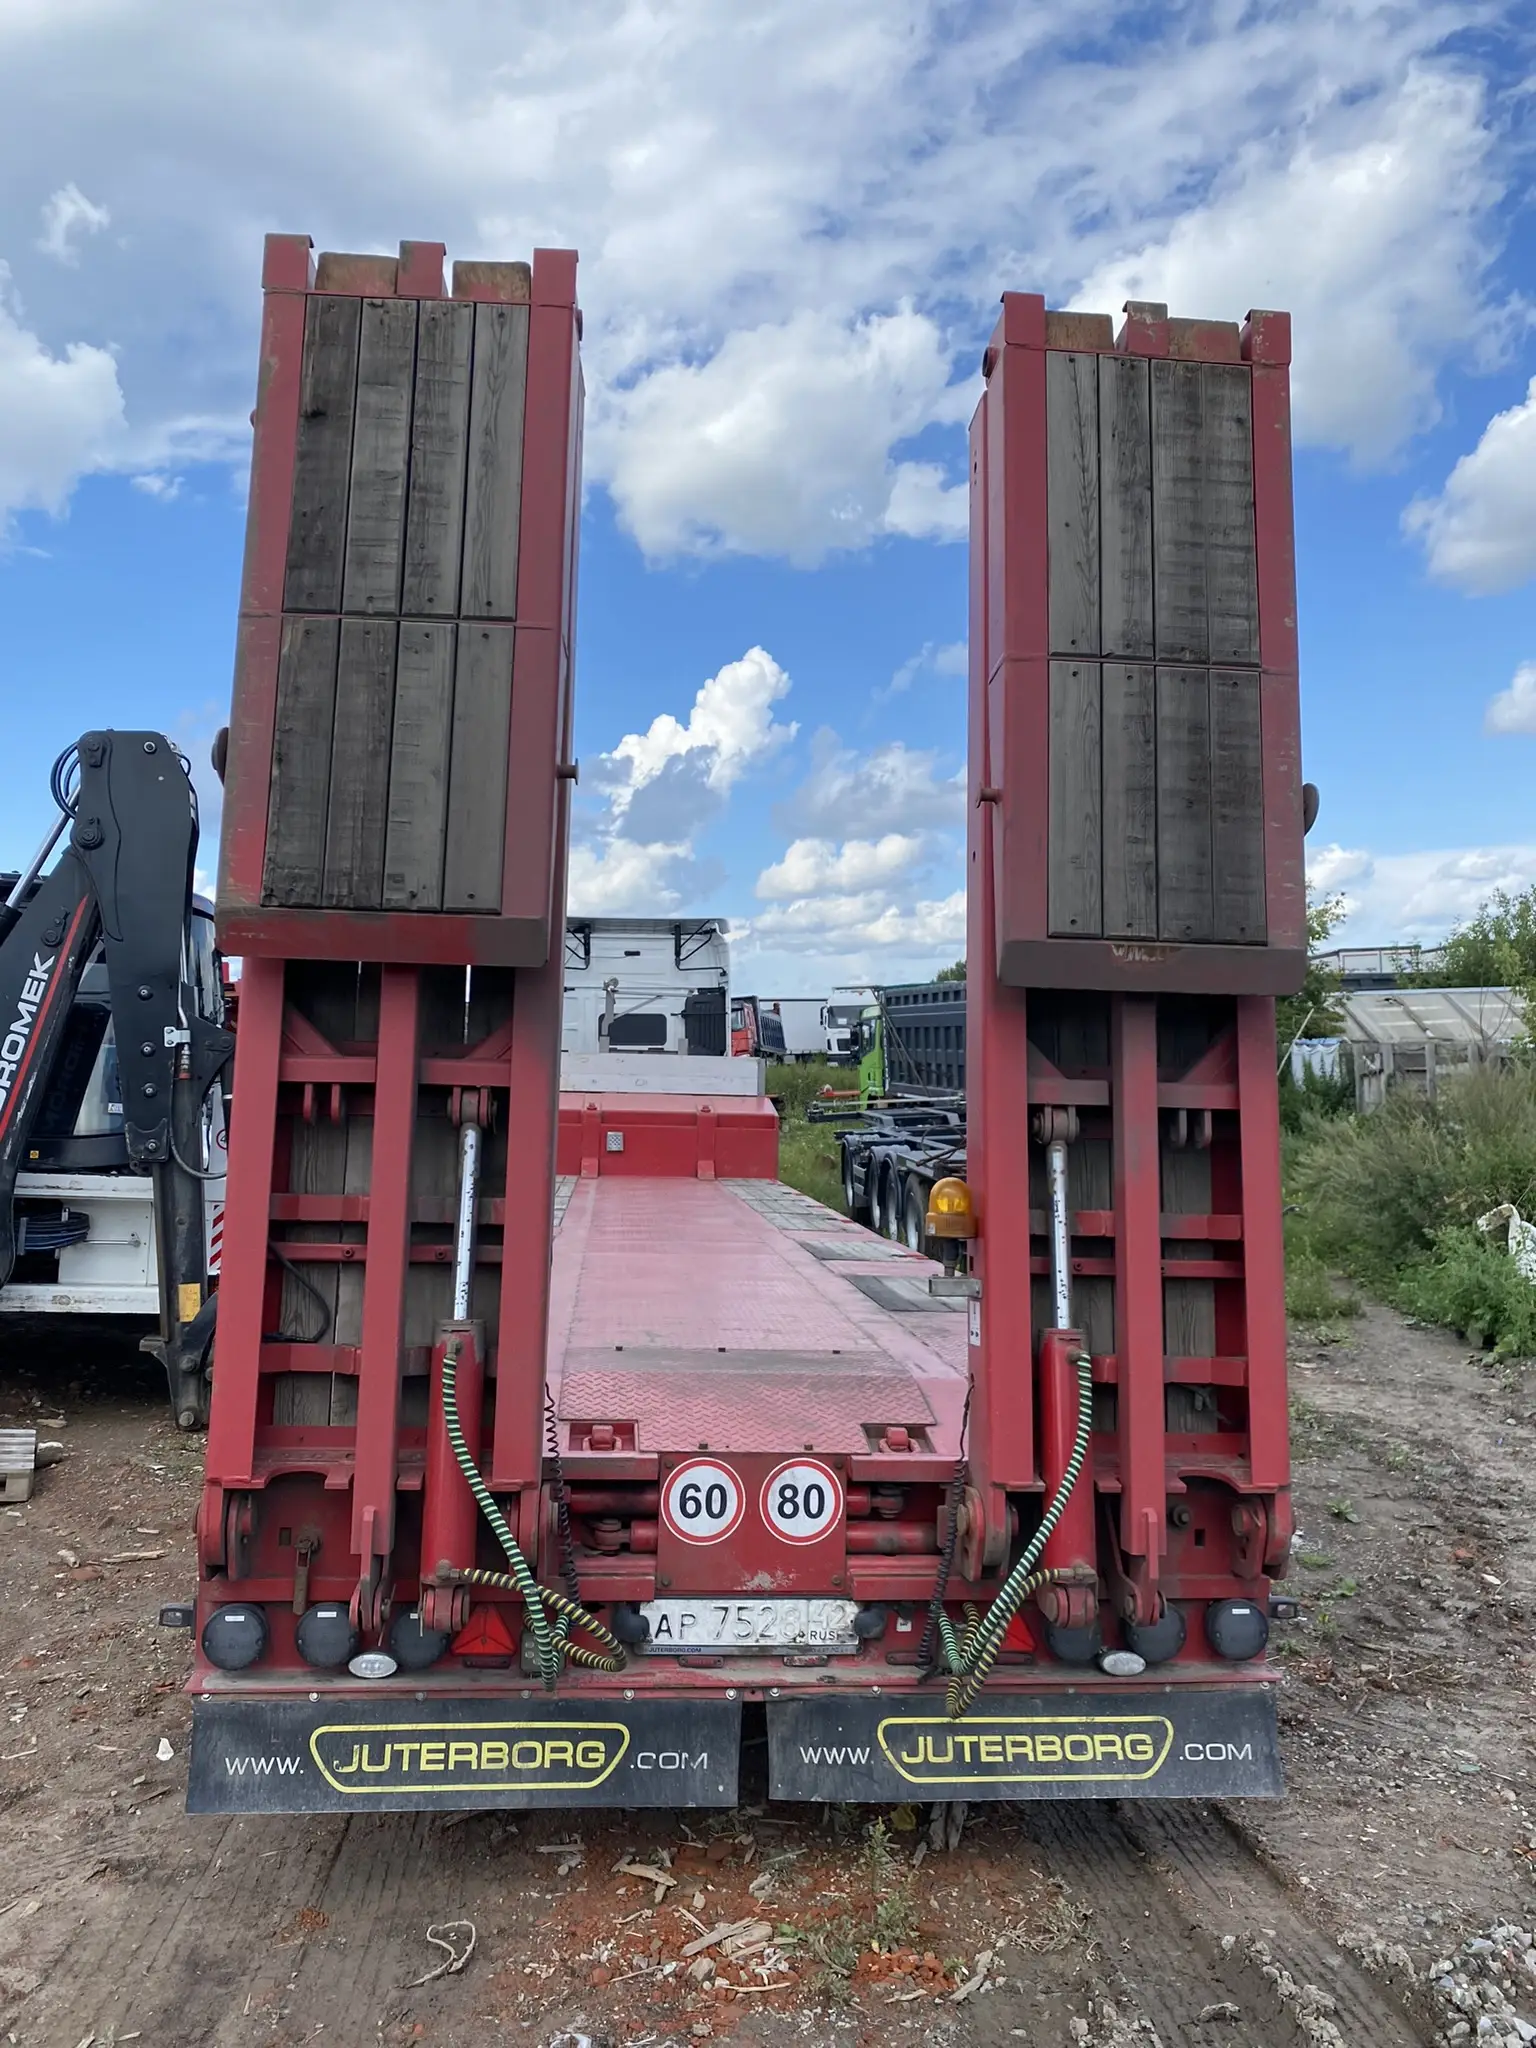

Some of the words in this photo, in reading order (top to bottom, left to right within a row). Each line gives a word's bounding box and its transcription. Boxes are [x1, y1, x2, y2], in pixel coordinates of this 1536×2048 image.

[679, 1483, 728, 1519] 60
[777, 1483, 825, 1519] 80
[810, 1630, 836, 1641] RUS
[333, 1740, 606, 1774] JUTERBORG
[901, 1733, 1154, 1764] JUTERBORG
